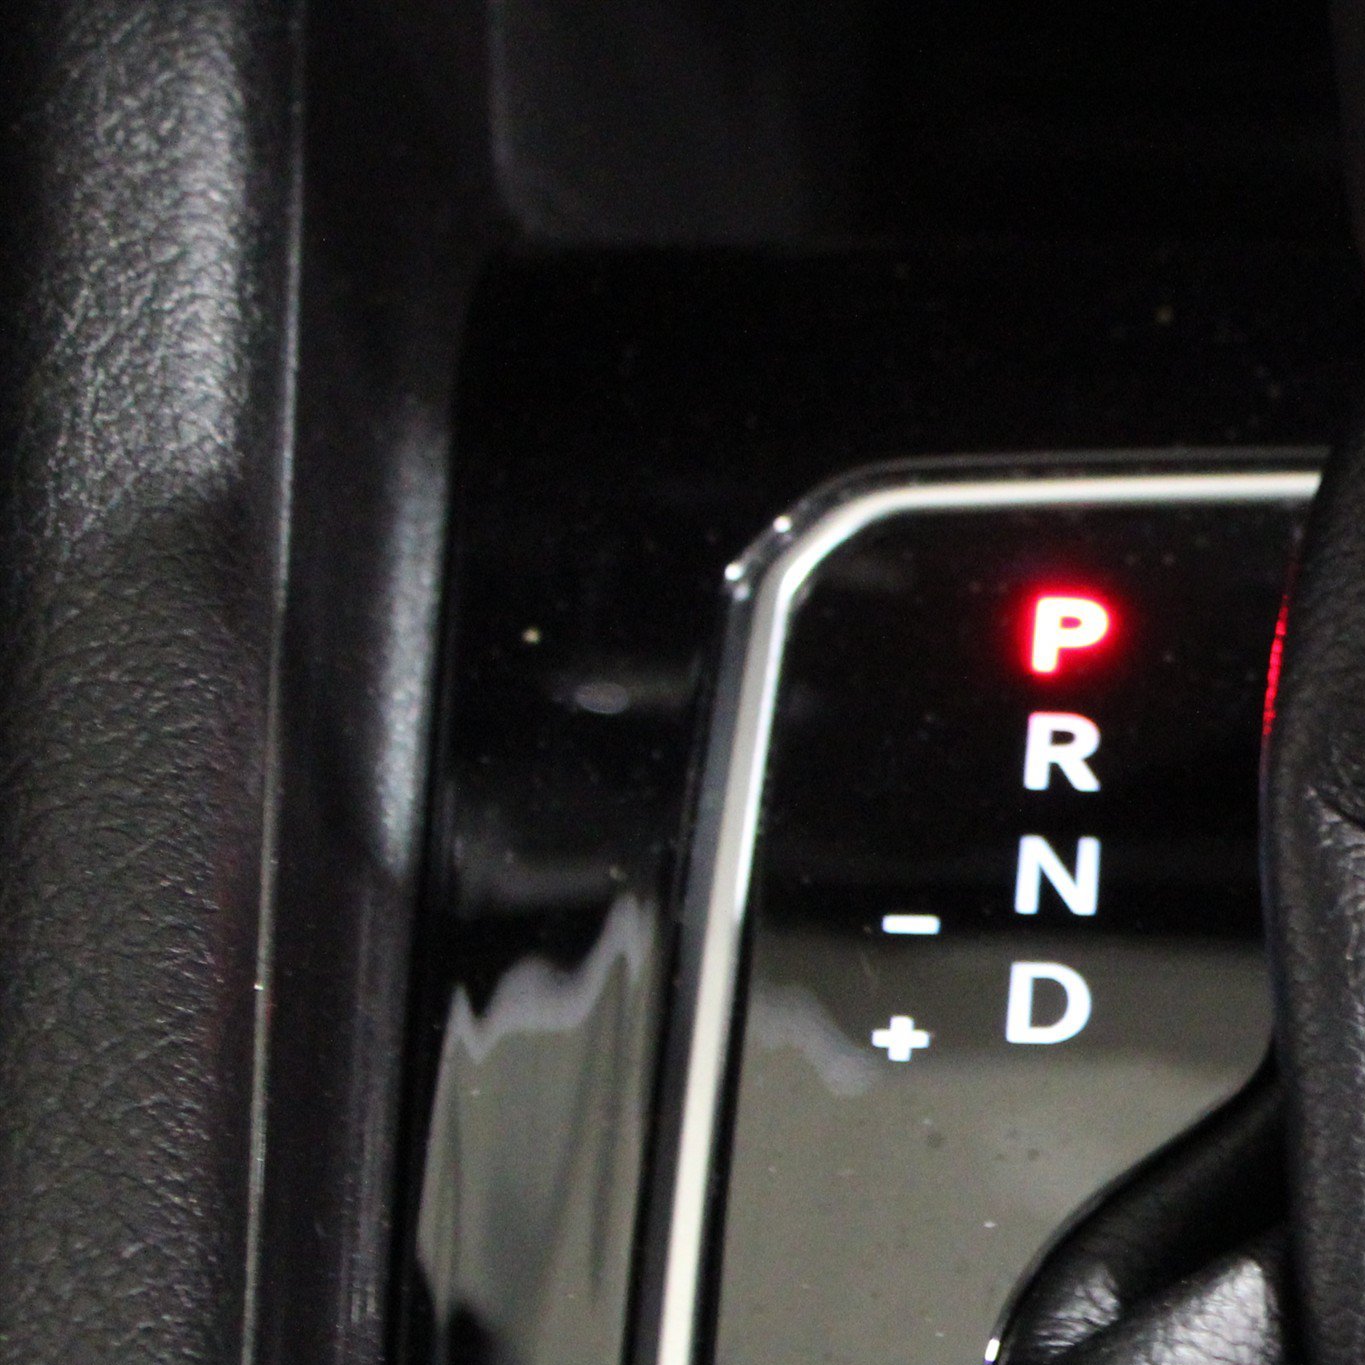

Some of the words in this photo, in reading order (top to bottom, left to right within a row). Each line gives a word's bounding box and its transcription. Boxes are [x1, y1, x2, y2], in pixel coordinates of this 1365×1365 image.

[1023, 711, 1102, 793] R
[1014, 834, 1102, 917] N
[1005, 961, 1093, 1045] D
